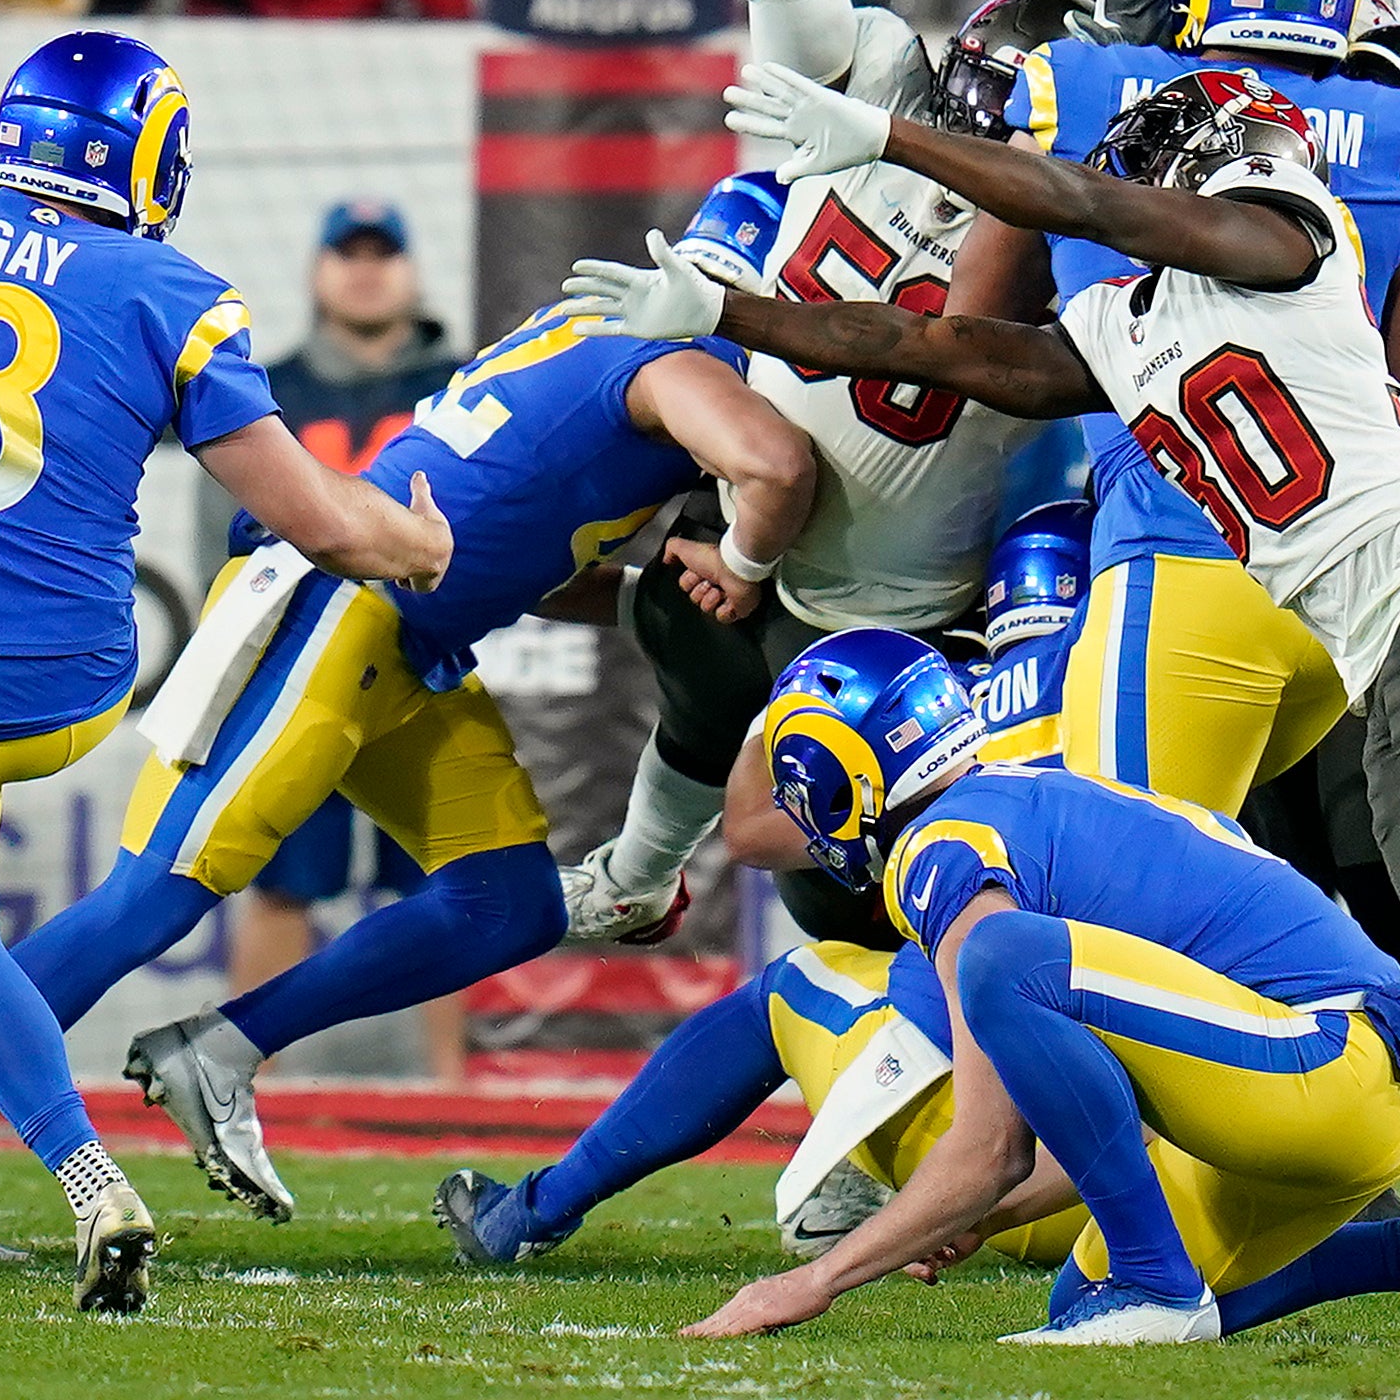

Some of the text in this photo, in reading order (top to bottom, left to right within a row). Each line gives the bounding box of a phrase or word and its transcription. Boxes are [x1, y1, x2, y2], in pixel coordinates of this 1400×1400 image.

[1230, 29, 1337, 50] LOS ANGELES
[19, 175, 99, 202] ANGELES
[888, 207, 957, 267] BUAEERS
[986, 614, 1072, 642] LOS ANGELE
[970, 656, 1039, 723] TON
[917, 752, 948, 780] LOS
[949, 726, 989, 757] ANGEL
